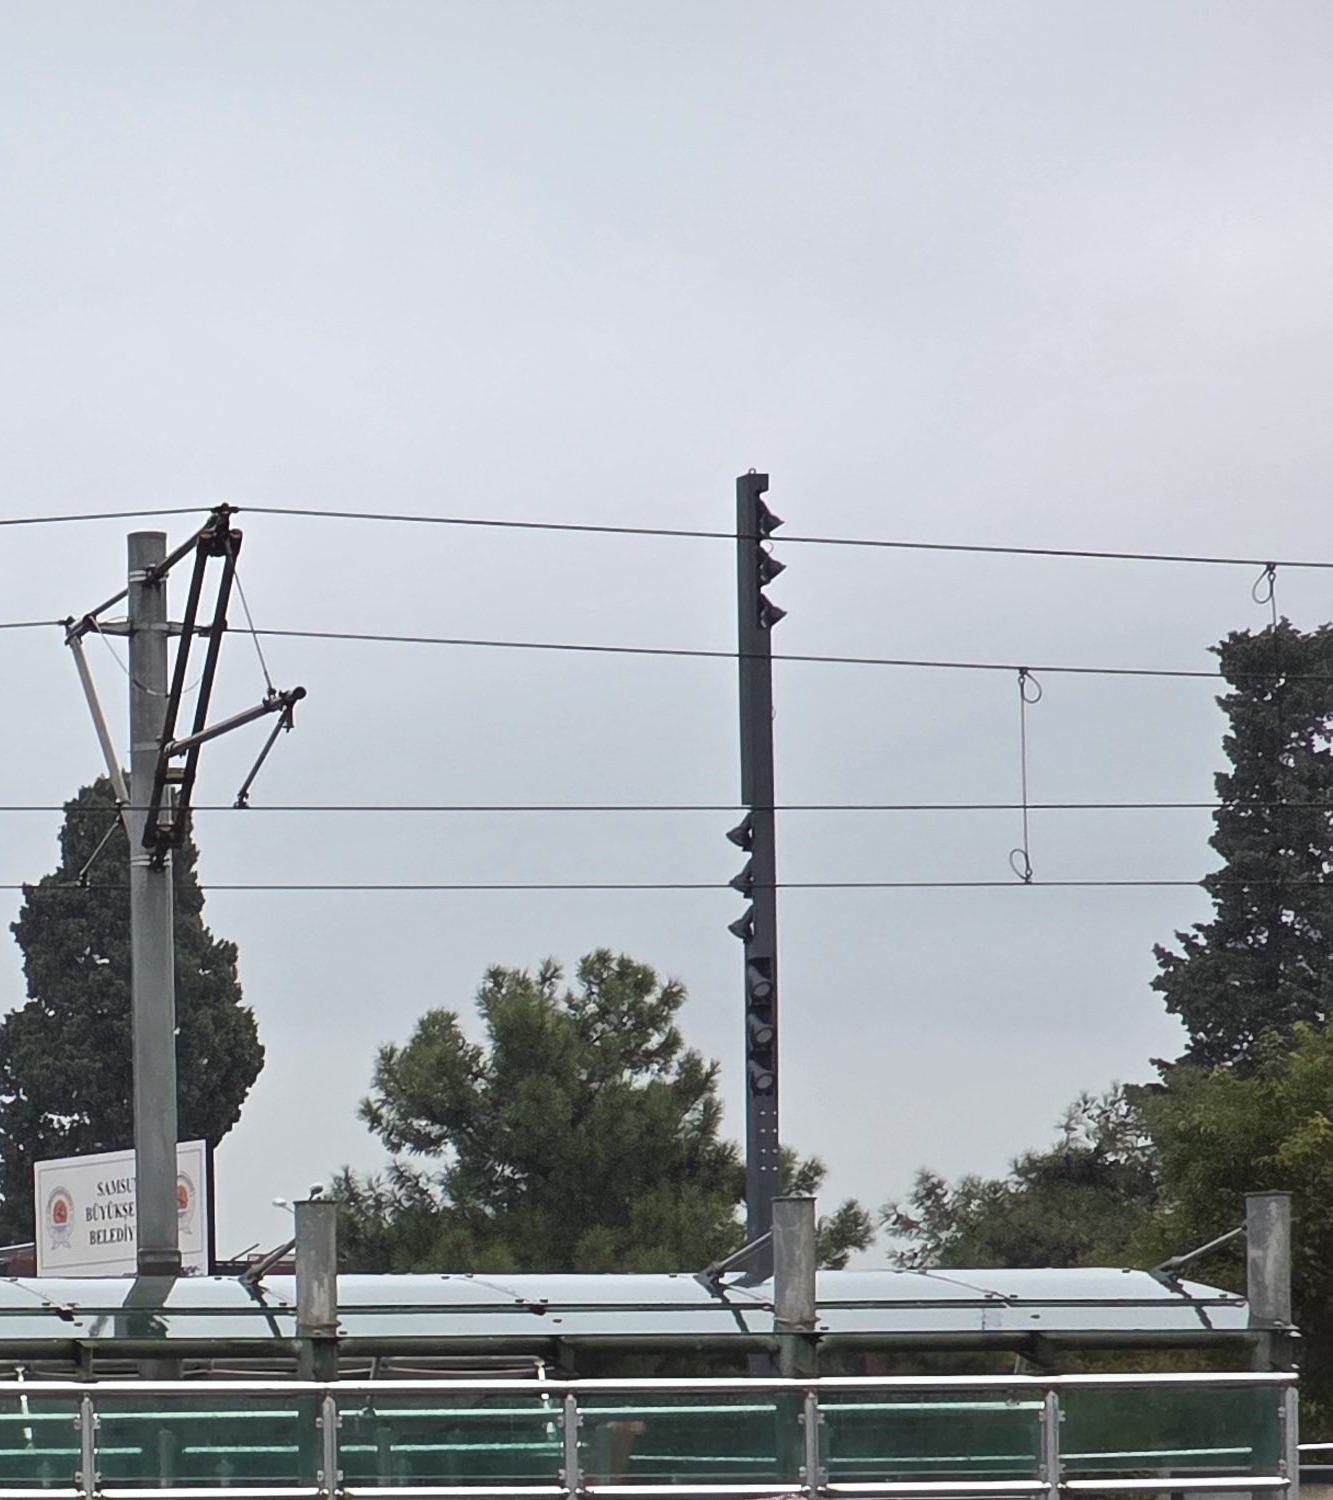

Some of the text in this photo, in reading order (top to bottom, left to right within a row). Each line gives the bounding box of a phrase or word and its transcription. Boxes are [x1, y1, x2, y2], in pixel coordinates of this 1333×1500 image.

[97, 1178, 135, 1196] SAMSU
[86, 1200, 135, 1221] BÜYÜKŞE
[90, 1224, 135, 1245] BELEDİY
